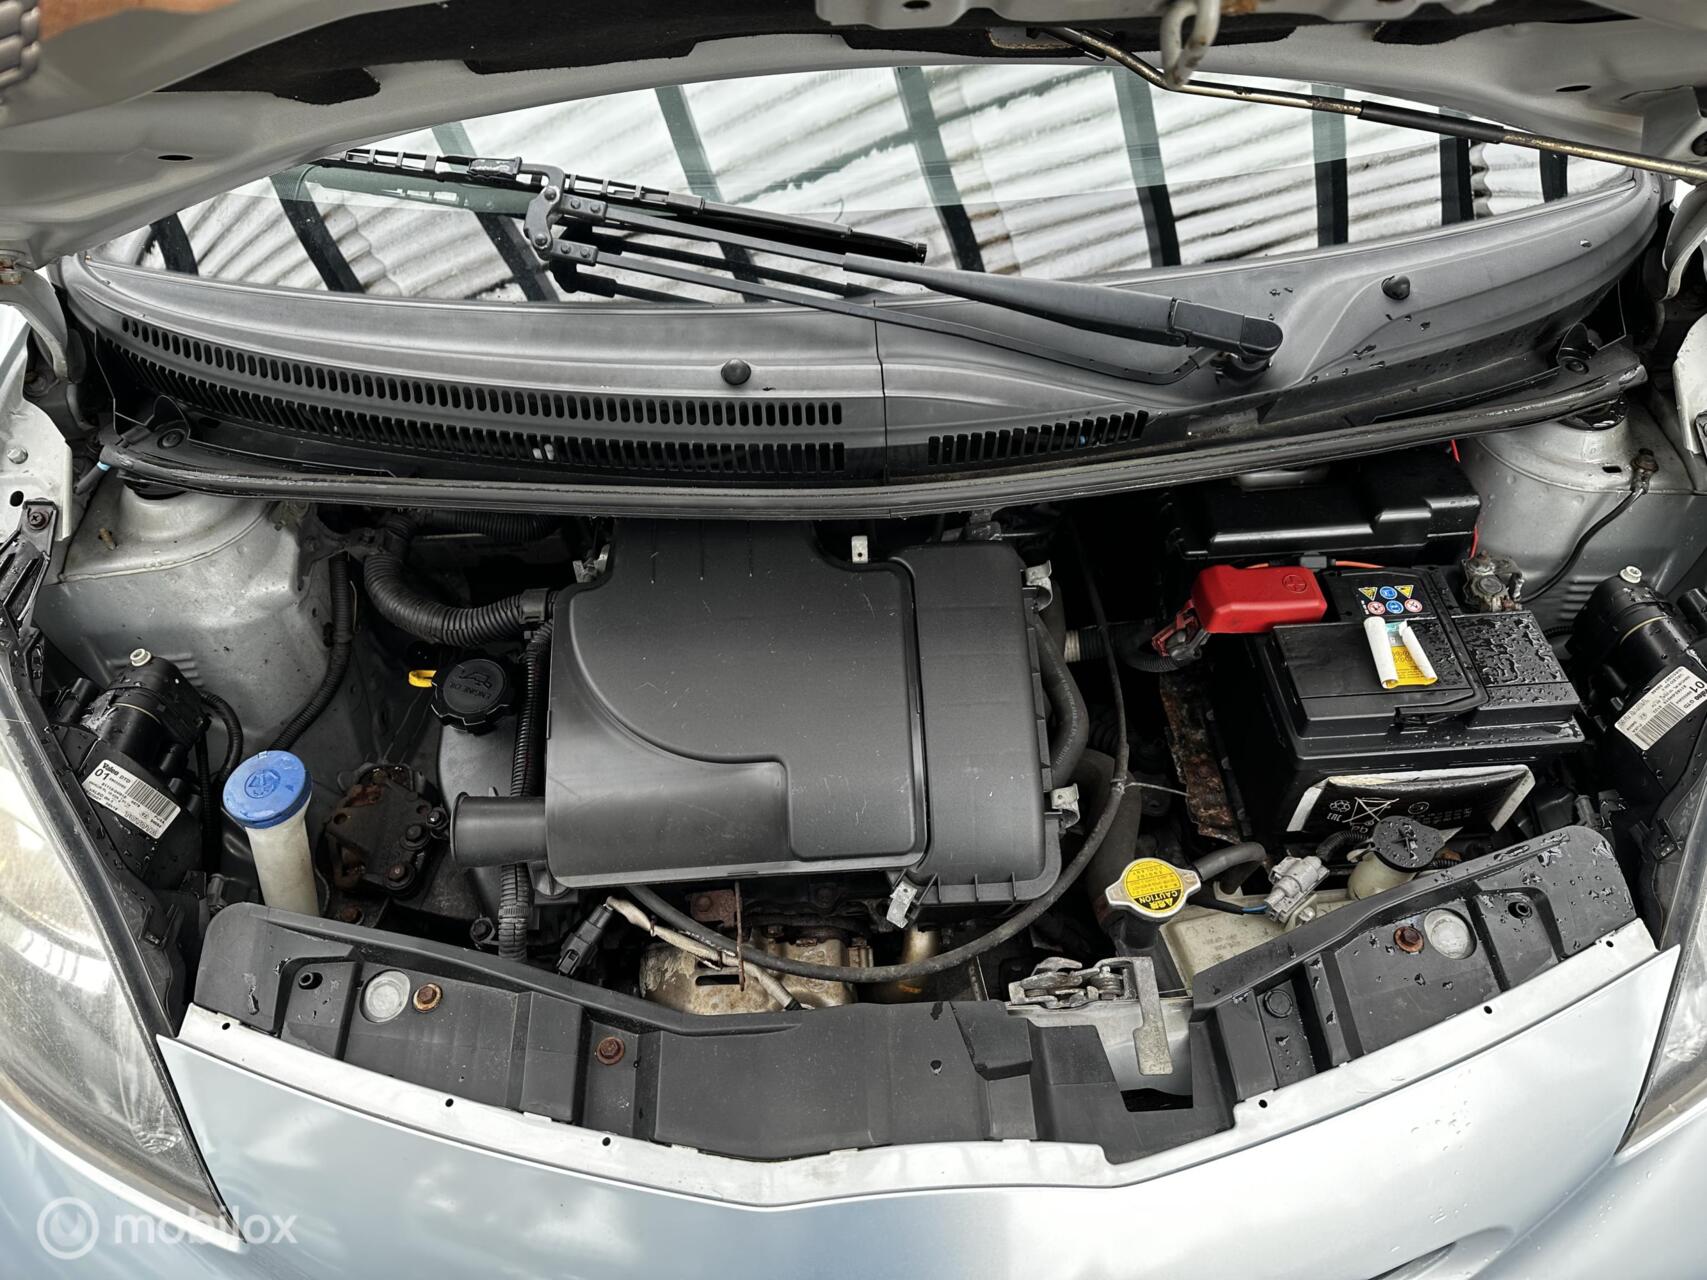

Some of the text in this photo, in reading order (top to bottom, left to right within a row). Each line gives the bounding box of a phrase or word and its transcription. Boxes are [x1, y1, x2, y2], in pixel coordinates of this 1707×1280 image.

[1689, 681, 1705, 693] 01
[94, 768, 110, 780] 01
[102, 762, 119, 776] Valeo
[1138, 890, 1178, 904] CAUTION
